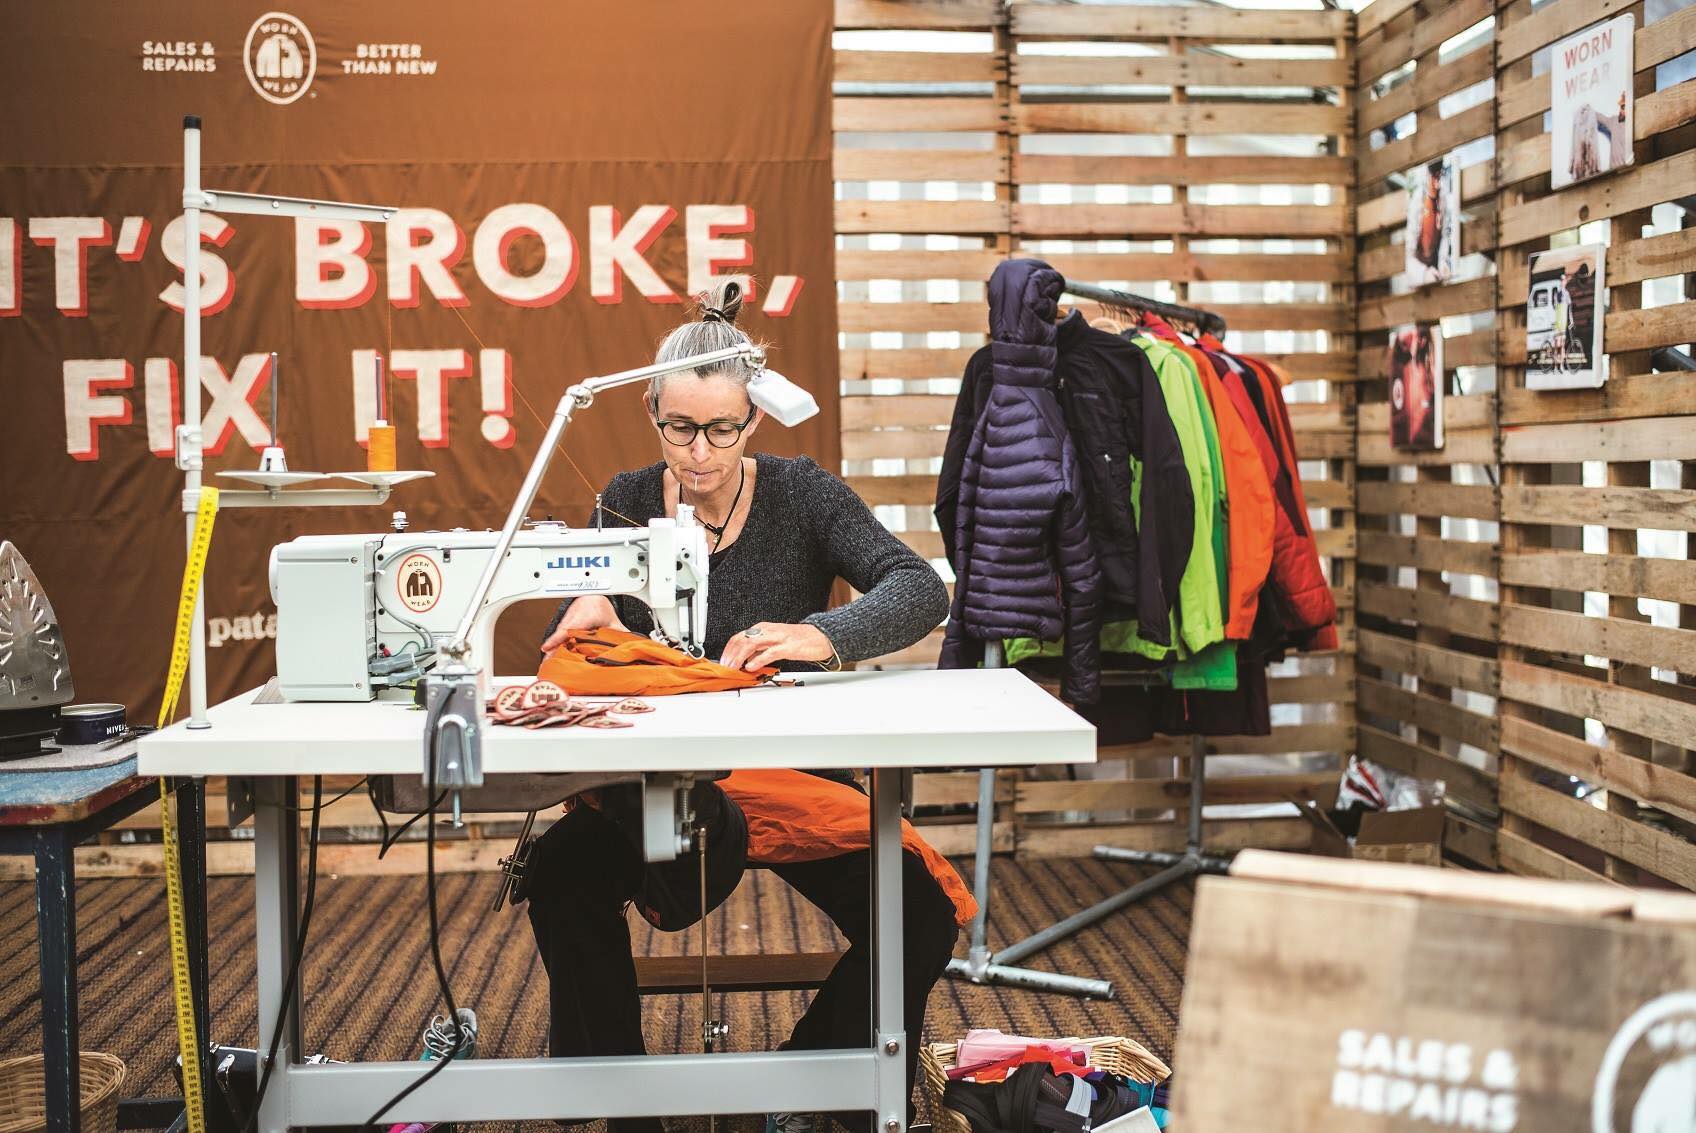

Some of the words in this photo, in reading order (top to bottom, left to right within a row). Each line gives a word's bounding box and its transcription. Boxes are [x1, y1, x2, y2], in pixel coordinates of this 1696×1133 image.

[142, 41, 197, 56] SALES
[201, 41, 215, 56] &
[356, 44, 422, 58] BETTER
[1564, 28, 1612, 70] WORN
[142, 57, 217, 72] REPAIRS
[342, 60, 392, 75] THAN
[396, 60, 437, 75] NEW
[1565, 61, 1611, 98] WEAR
[294, 203, 805, 318] BROKE,
[63, 352, 285, 461] FIX
[352, 348, 516, 449] IT!
[547, 556, 611, 569] JUKI
[410, 599, 432, 607] WEAR
[1337, 1029, 1471, 1083] SALES
[1332, 1070, 1518, 1133] REPAIRS
